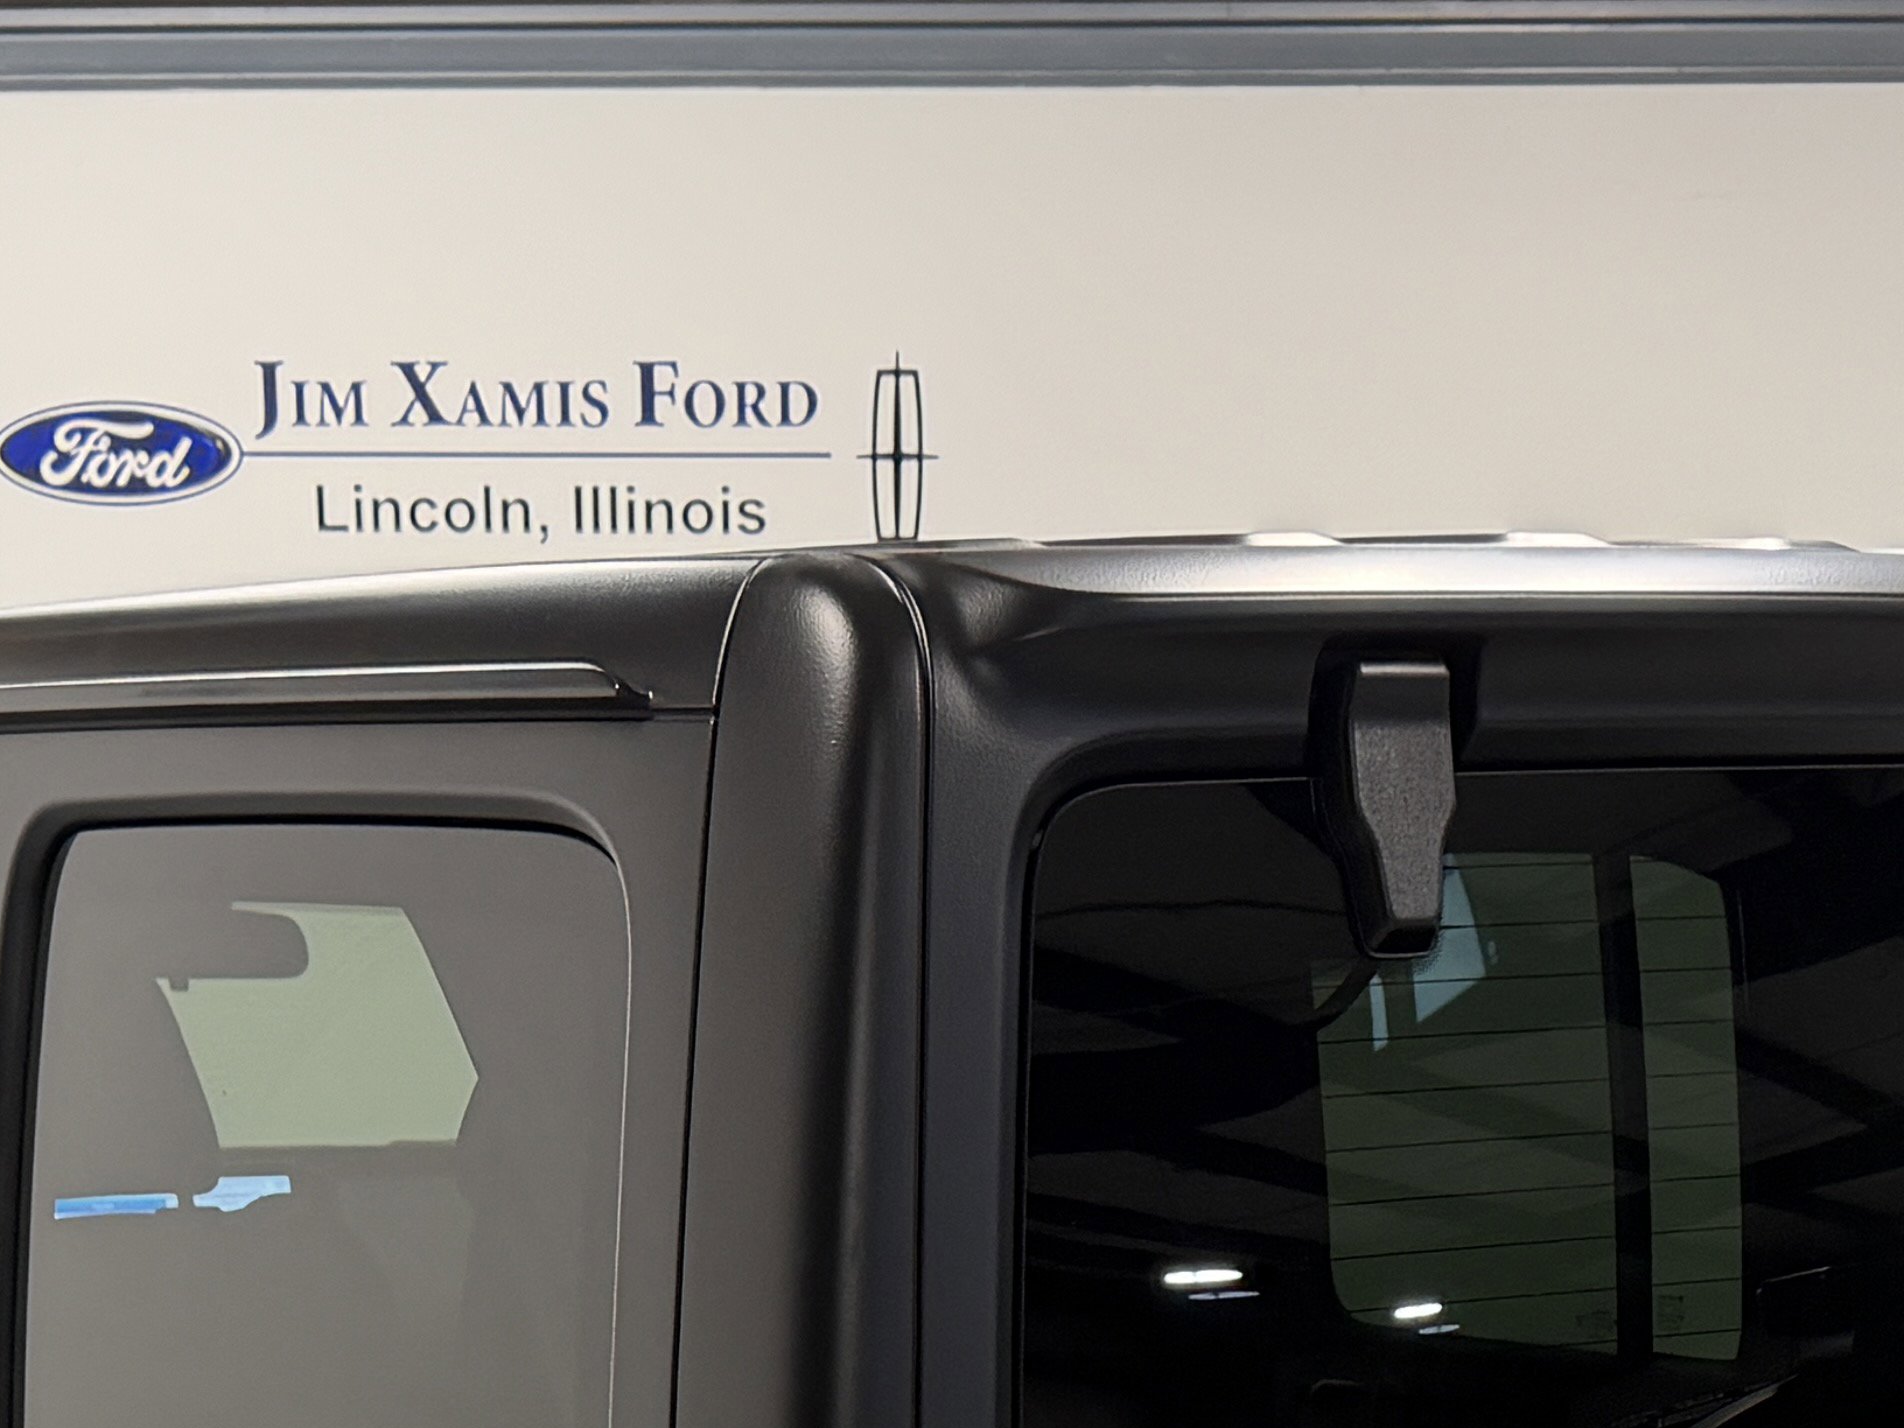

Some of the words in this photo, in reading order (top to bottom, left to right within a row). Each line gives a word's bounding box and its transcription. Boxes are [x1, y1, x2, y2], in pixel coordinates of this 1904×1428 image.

[40, 418, 193, 487] Ford
[317, 484, 549, 544] Lincoln,
[575, 486, 766, 535] Illinois
